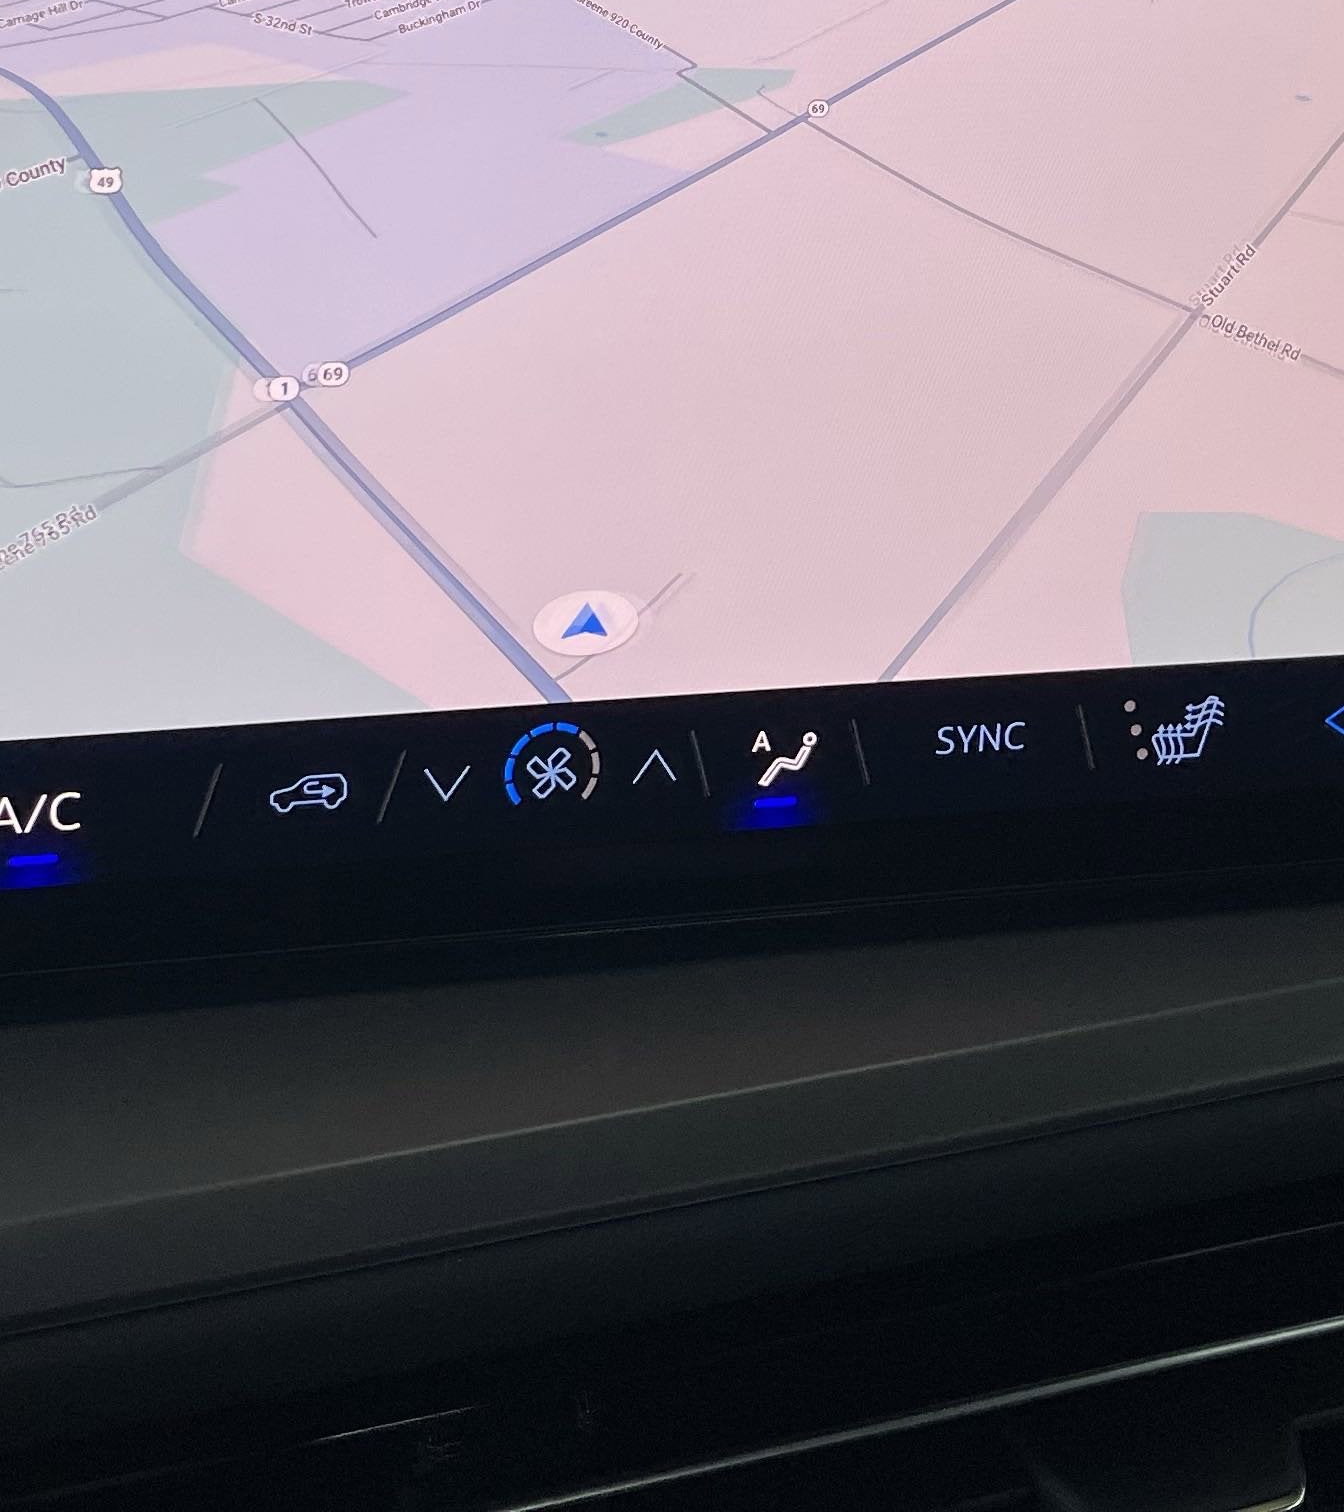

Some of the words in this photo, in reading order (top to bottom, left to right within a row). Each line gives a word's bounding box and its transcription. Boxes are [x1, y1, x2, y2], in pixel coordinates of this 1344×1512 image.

[48, 2, 68, 17] Hill
[69, 0, 84, 11] Dr
[398, 5, 466, 34] Buckingham
[467, 0, 481, 11] Dr
[254, 13, 264, 25] S
[264, 16, 297, 32] 32nd
[299, 23, 312, 35] St
[609, 13, 629, 29] 920
[629, 24, 663, 50] County
[811, 103, 825, 114] 69
[6, 158, 66, 187] County
[97, 176, 114, 188] 49
[1201, 265, 1240, 307] Stuart
[1236, 244, 1256, 267] Rd
[1211, 315, 1236, 335] Old
[1236, 324, 1280, 352] Bethel
[1281, 342, 1302, 361] Rd
[323, 367, 343, 381] 69
[935, 722, 1025, 756] SYNC
